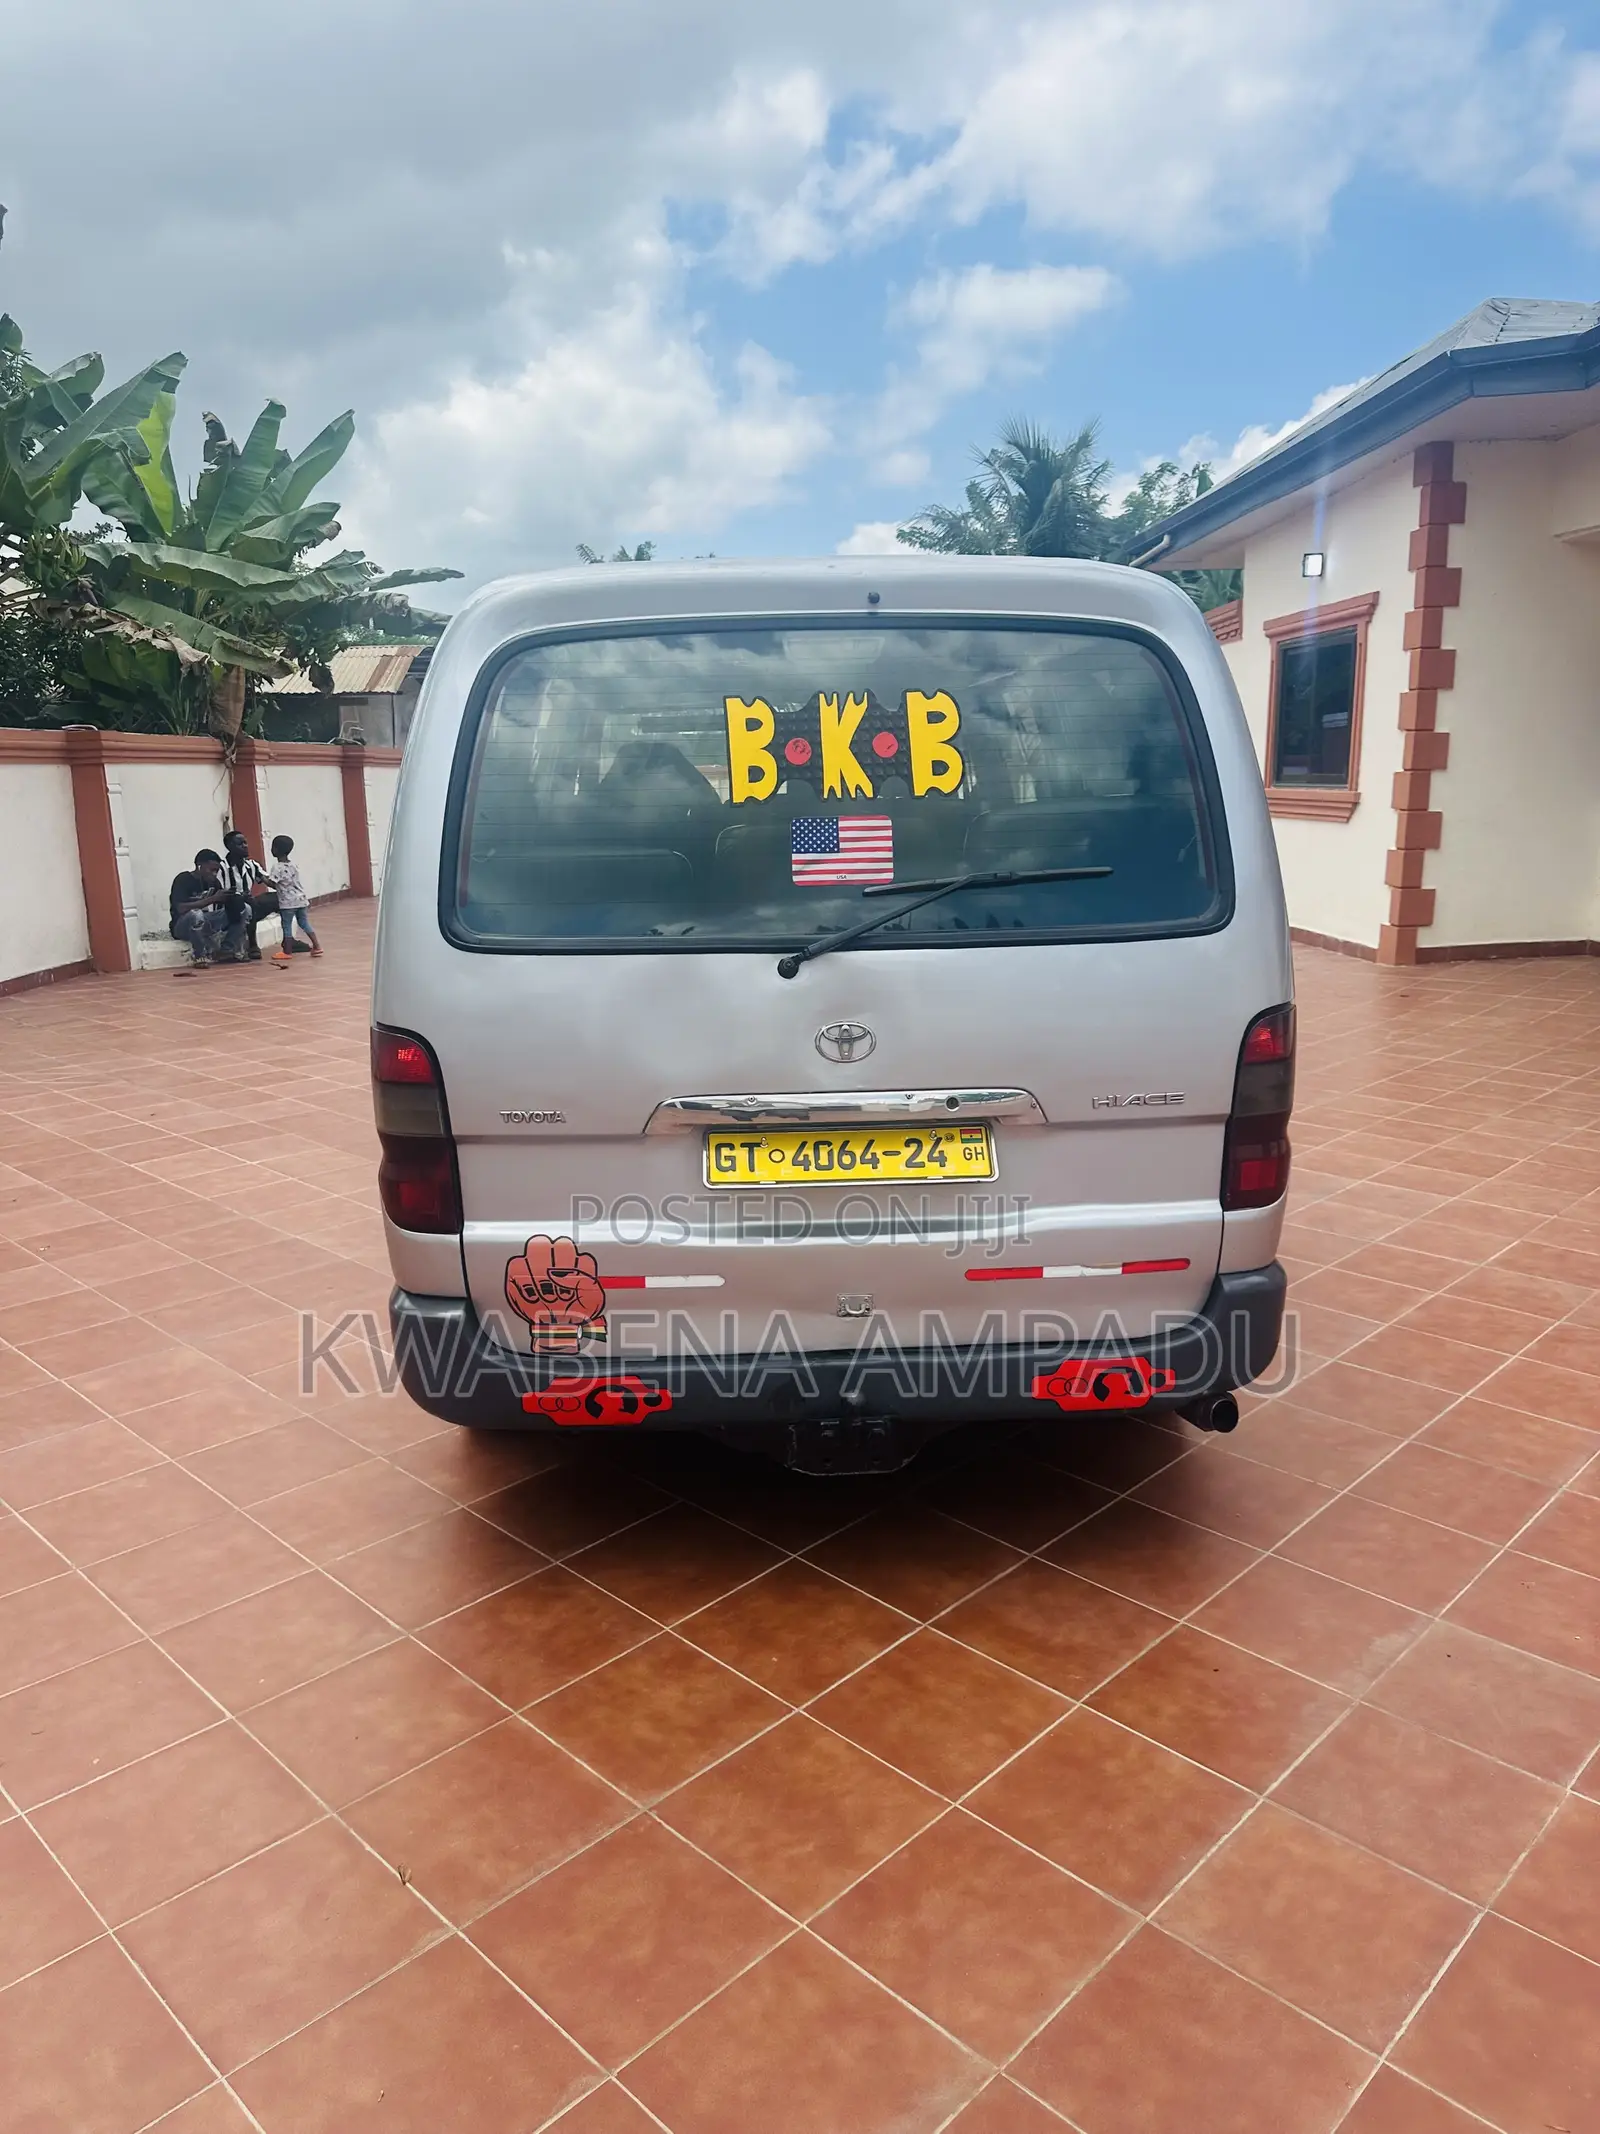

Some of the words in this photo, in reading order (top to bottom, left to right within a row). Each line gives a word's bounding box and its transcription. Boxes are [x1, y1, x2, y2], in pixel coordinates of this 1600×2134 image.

[1092, 1092, 1185, 1109] HIACE
[499, 1110, 566, 1123] TOYOTA
[714, 1142, 762, 1172] GT
[791, 1136, 948, 1172] 4064-24
[963, 1146, 985, 1161] GH
